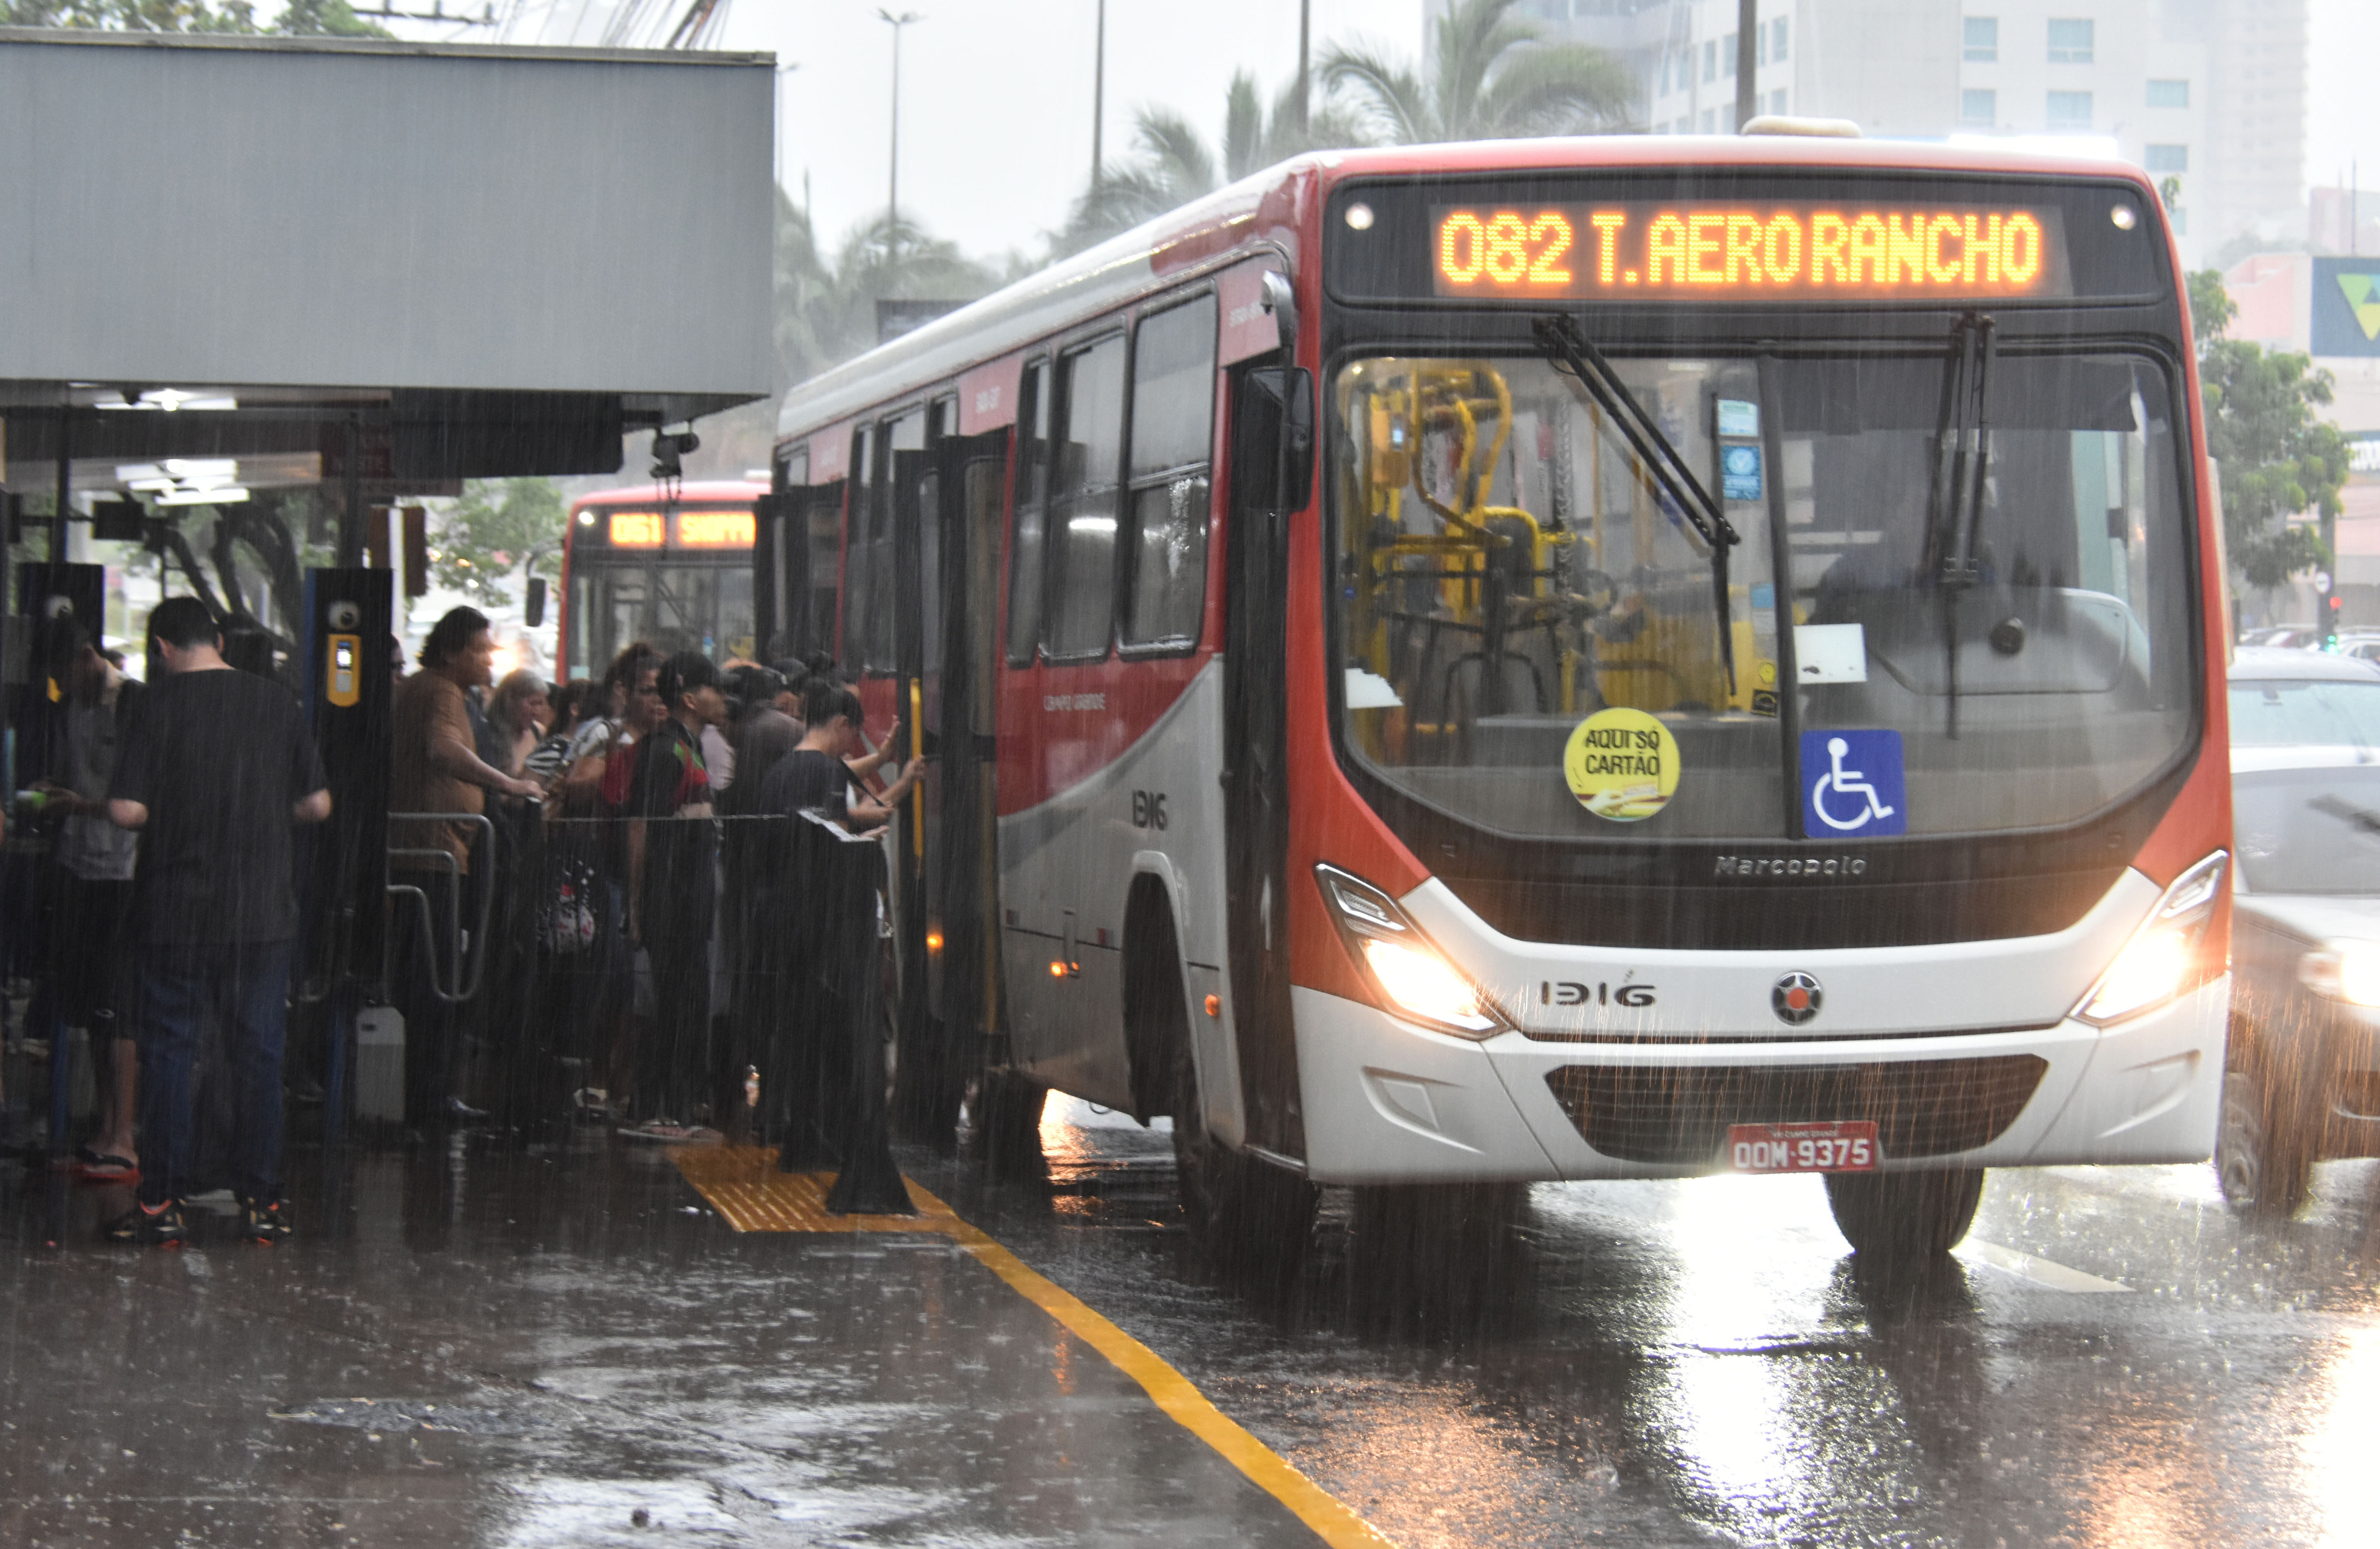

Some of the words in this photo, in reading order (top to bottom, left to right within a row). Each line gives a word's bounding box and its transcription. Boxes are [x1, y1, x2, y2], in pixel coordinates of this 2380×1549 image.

[1441, 214, 1571, 283] 082
[1592, 214, 1638, 283] T.
[1649, 214, 1801, 283] AERO
[1812, 214, 2040, 283] RANCHO
[613, 515, 661, 543] 051
[1585, 729, 1630, 748] AQUI
[1635, 725, 1660, 749] SÓ
[1586, 752, 1661, 775] CARTÃO
[1132, 790, 1168, 831] 1316
[1713, 856, 1867, 877] Marcopolo
[1541, 980, 1656, 1007] 1316
